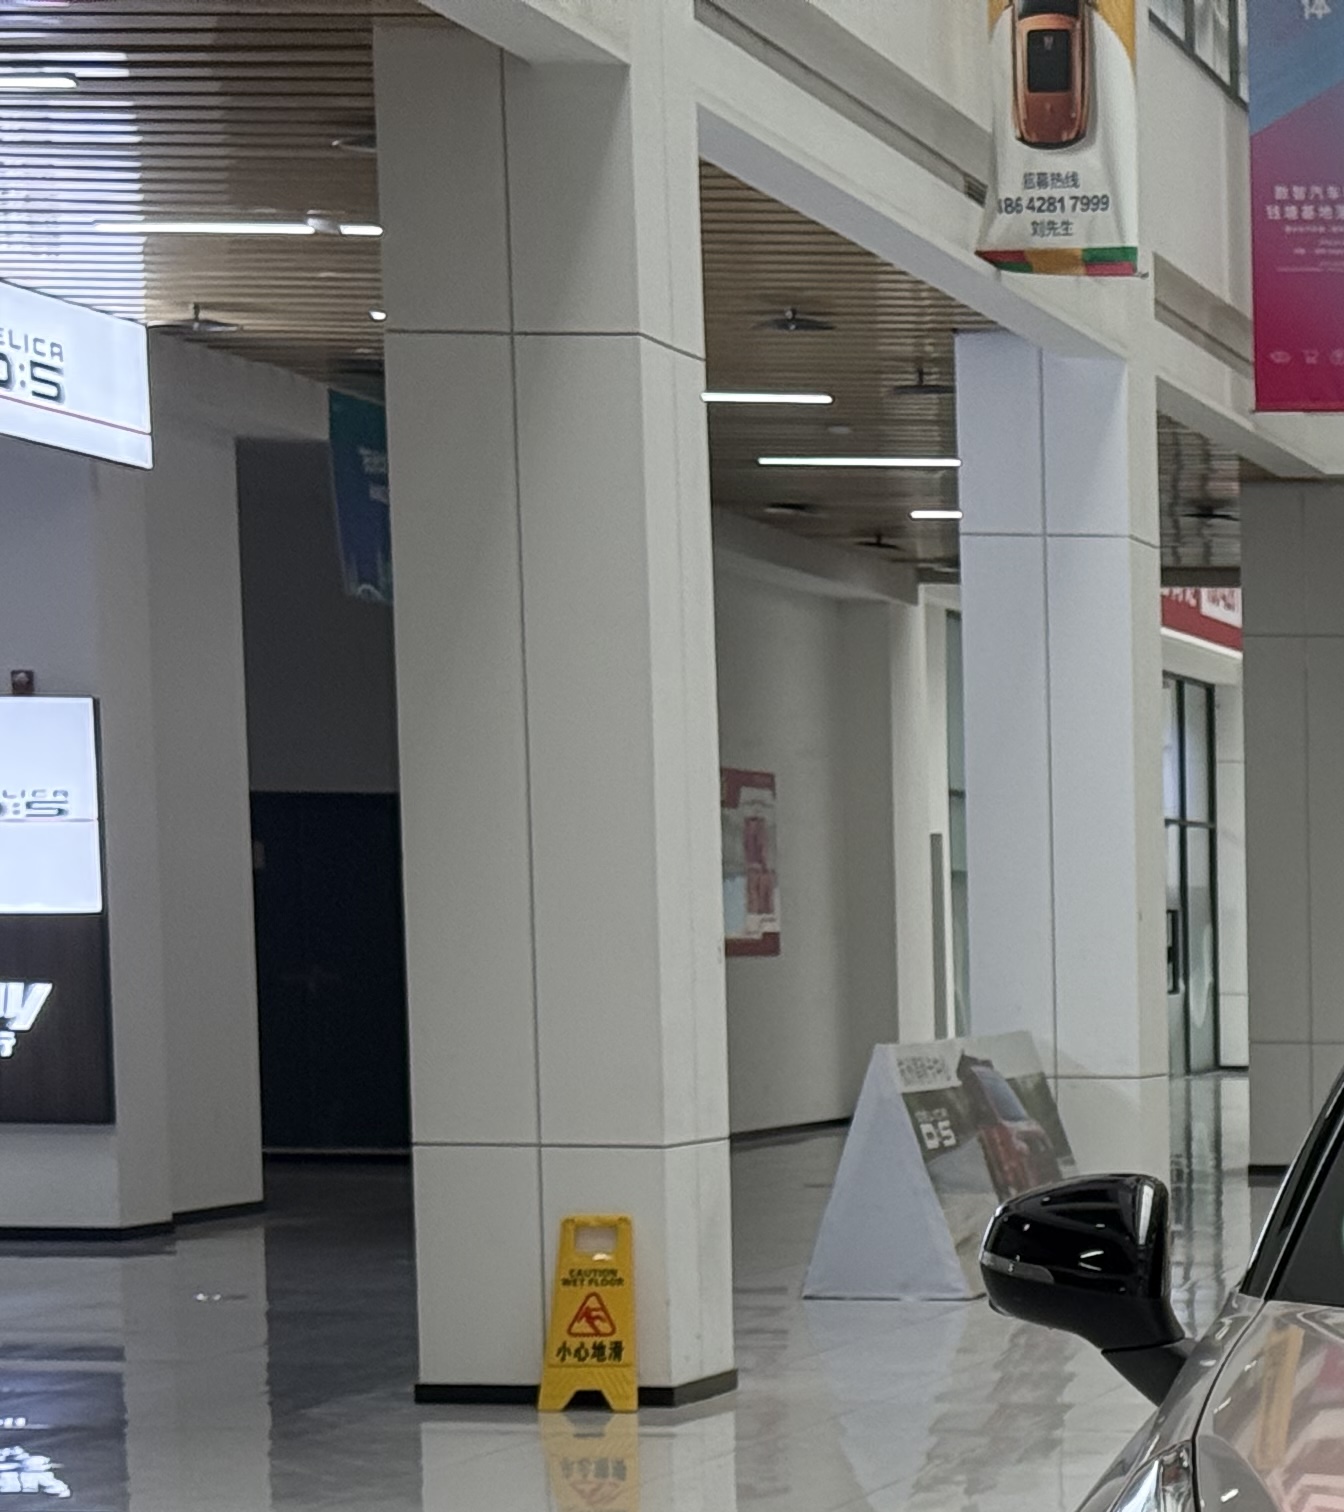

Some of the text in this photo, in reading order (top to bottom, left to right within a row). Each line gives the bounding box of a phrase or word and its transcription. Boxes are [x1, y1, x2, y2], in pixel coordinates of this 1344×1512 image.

[1025, 196, 1066, 213] 4281
[1069, 194, 1110, 212] 7999
[1031, 219, 1074, 237] 刘先生
[569, 1269, 618, 1277] CAUTION
[562, 1278, 624, 1287] WET FLOOR
[556, 1340, 625, 1363] 小心地滑
